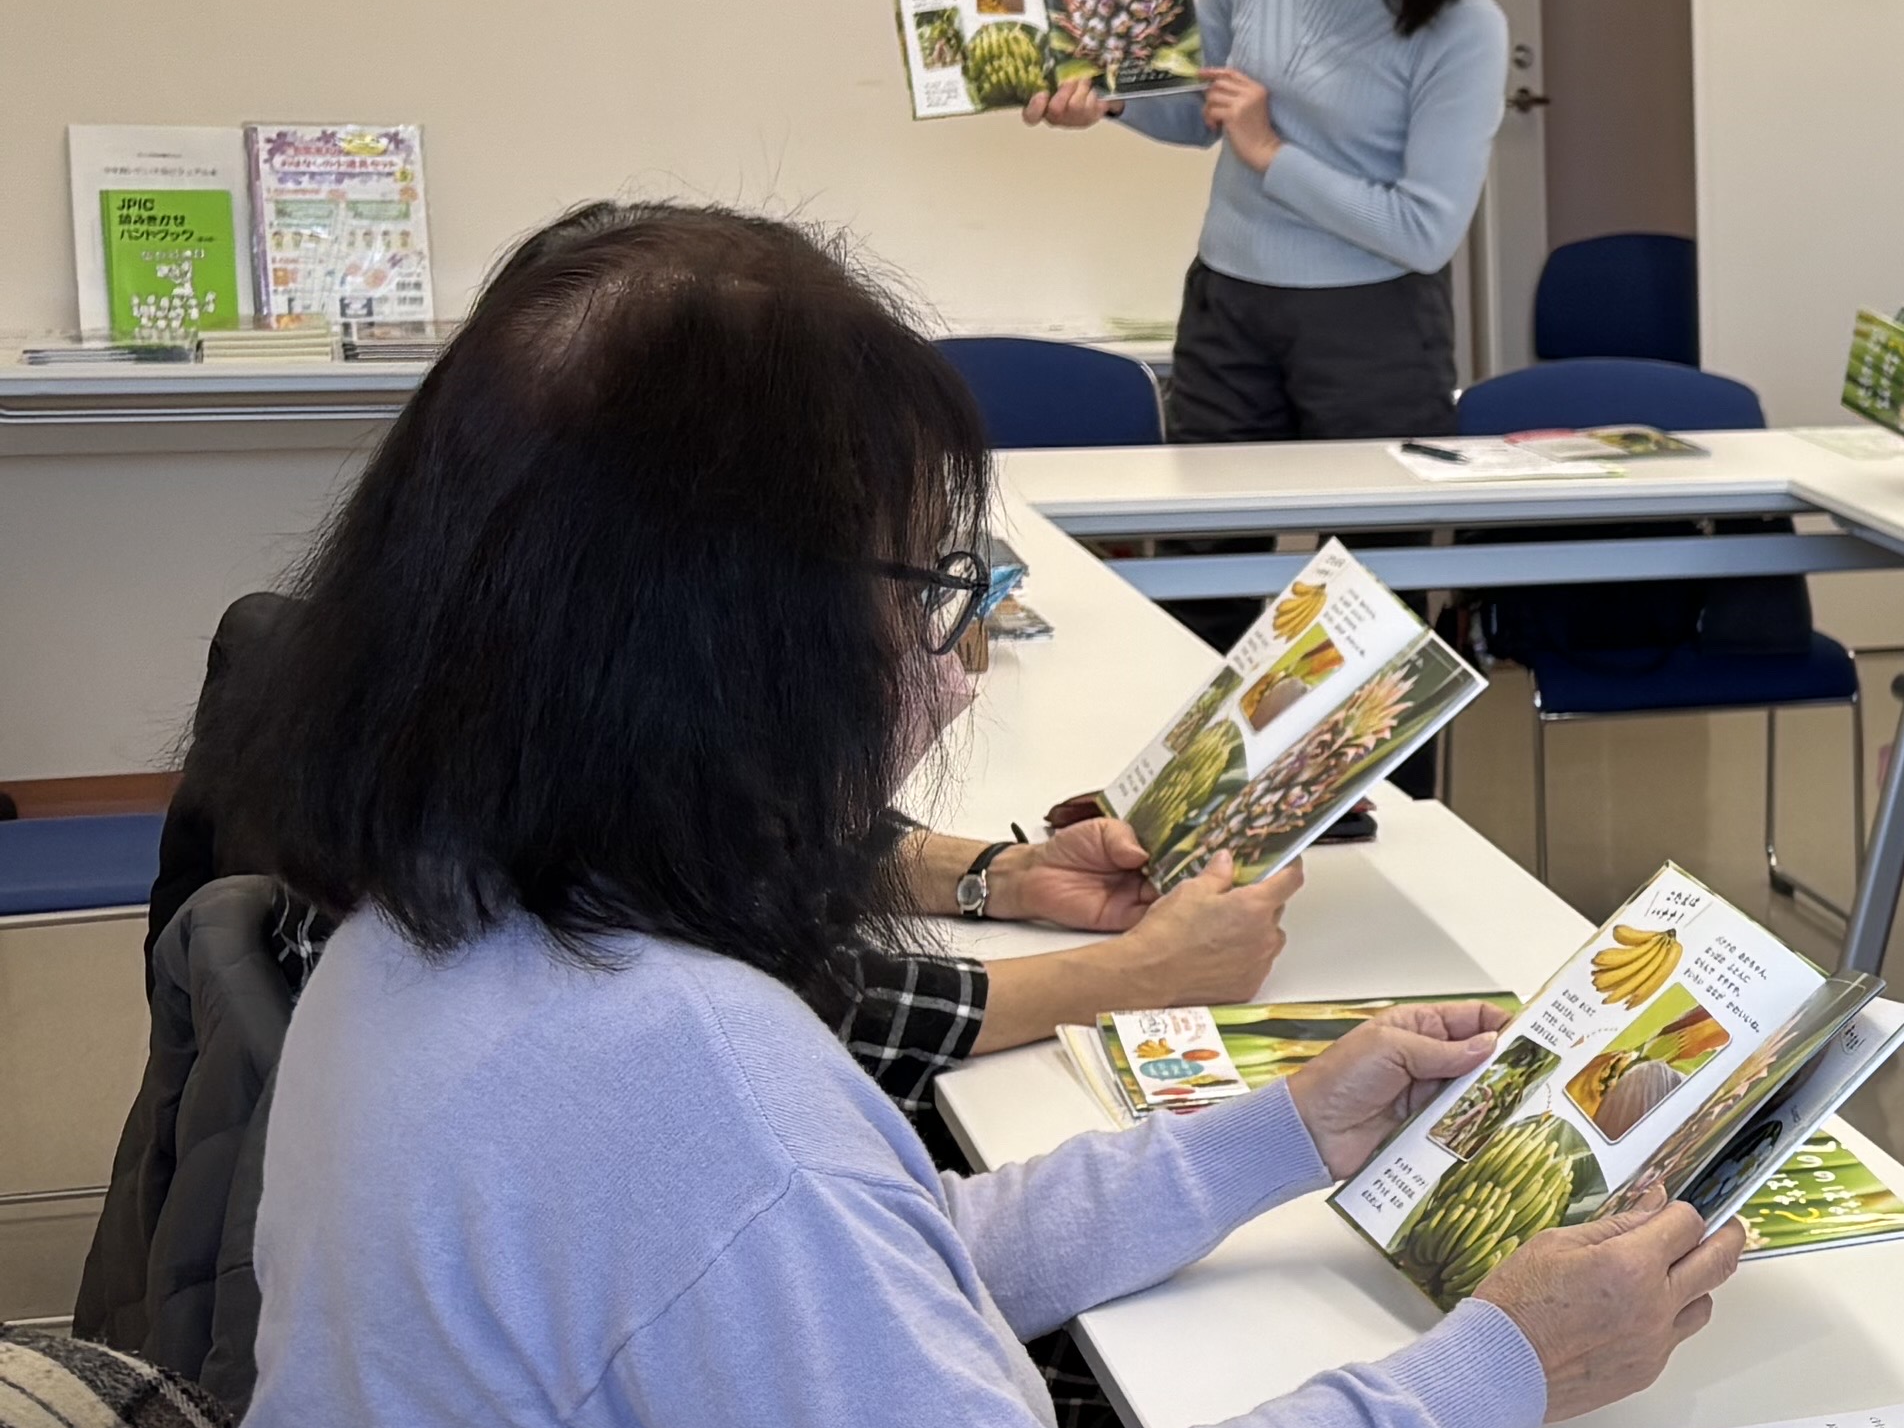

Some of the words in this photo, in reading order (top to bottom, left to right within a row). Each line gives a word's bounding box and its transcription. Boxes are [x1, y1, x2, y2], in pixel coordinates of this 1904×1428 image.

[117, 198, 155, 211] JPIC
[120, 229, 194, 242] ハンドブック
